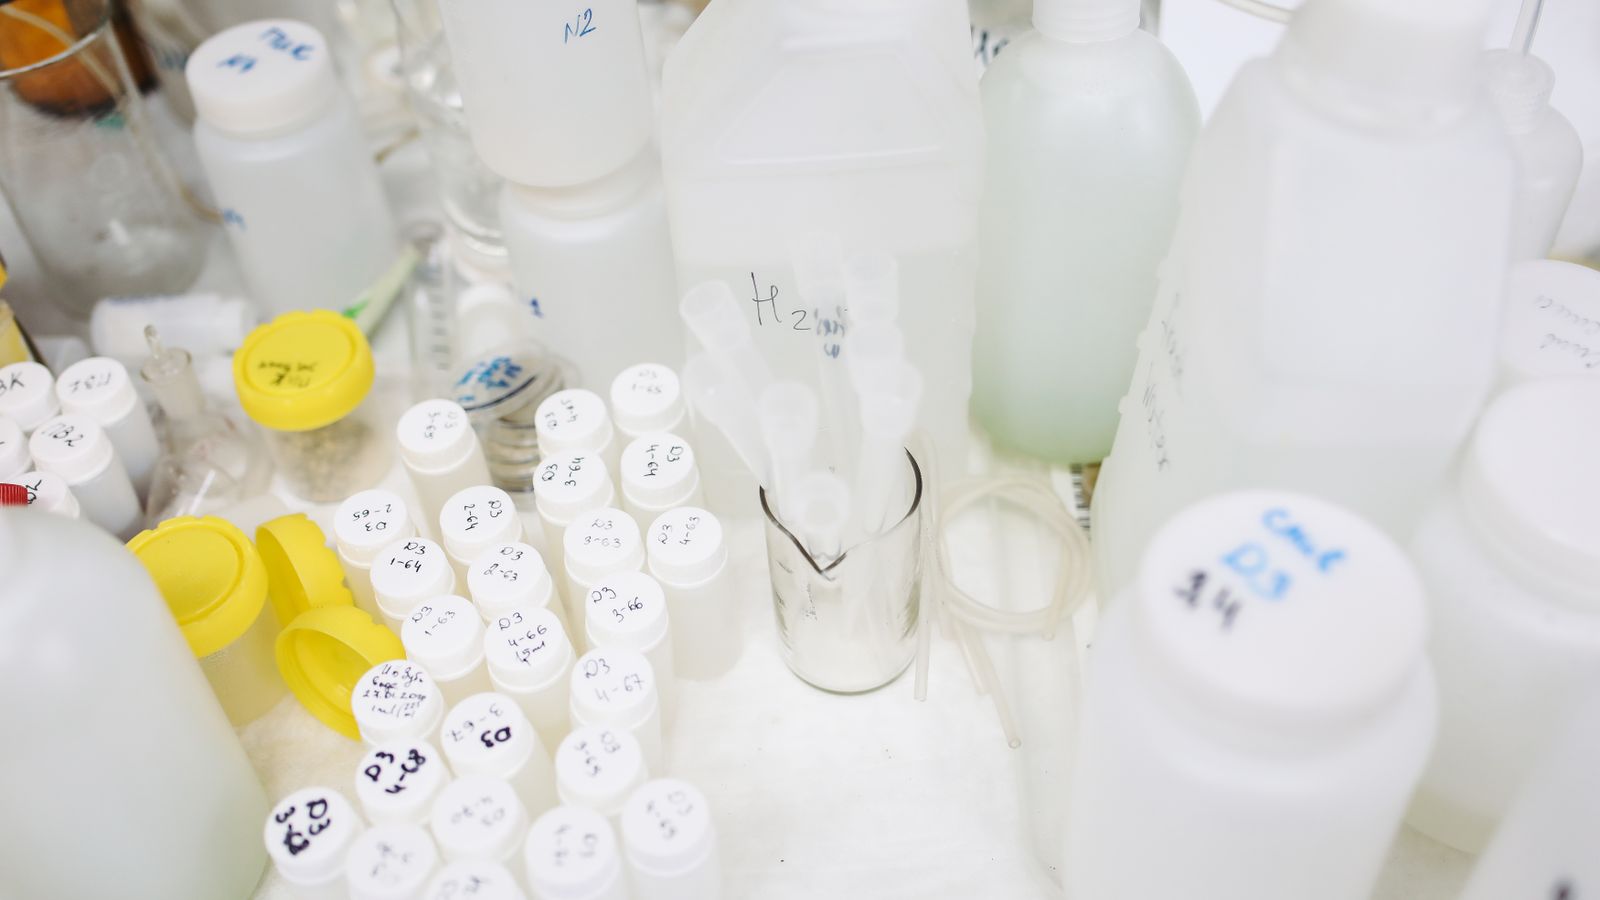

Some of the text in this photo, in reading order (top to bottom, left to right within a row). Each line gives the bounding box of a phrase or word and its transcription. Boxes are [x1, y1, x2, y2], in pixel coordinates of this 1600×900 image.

[643, 444, 660, 477] 4-64
[667, 445, 684, 463] D3
[541, 463, 559, 482] D3
[564, 456, 585, 487] 3-64
[353, 503, 393, 523] 2-65
[464, 503, 479, 532] 2-64
[487, 499, 503, 519] D3
[364, 521, 387, 533] D3
[591, 518, 614, 531] D3
[657, 524, 674, 545] D3
[403, 541, 427, 556] D3
[584, 535, 622, 549] 3-63
[499, 546, 525, 561] D3
[390, 557, 423, 573] 1-64
[590, 586, 617, 604] D3
[412, 605, 433, 624] D3
[611, 596, 645, 623] 3-66
[424, 610, 456, 636] 1-63
[498, 611, 524, 630] D3
[507, 624, 548, 648] 4-66
[583, 657, 612, 679] D3
[595, 675, 645, 703] 4-67
[480, 726, 513, 749] D3
[365, 750, 395, 782] D3
[305, 798, 331, 836] D3
